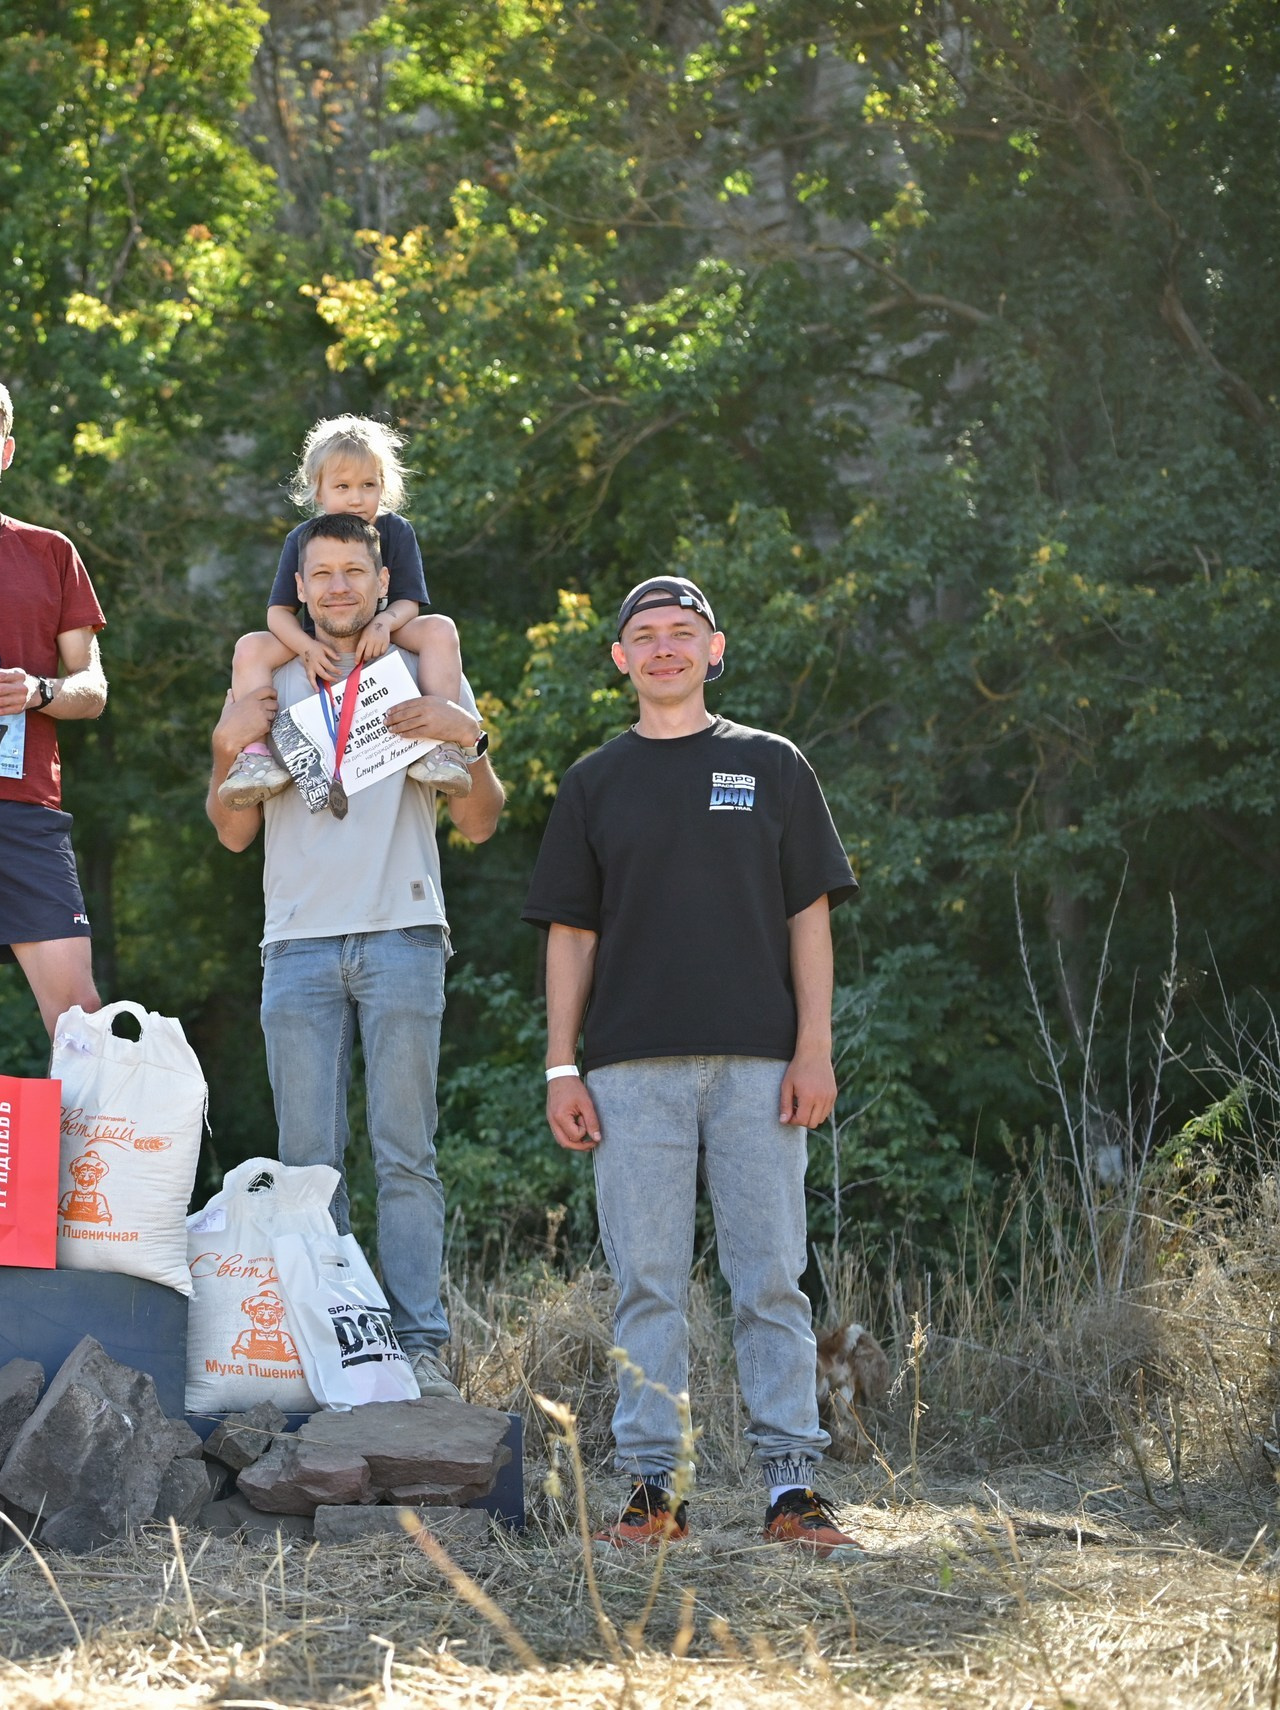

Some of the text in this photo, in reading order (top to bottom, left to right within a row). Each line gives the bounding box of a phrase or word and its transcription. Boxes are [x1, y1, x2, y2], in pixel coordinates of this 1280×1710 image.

[360, 687, 389, 708] МЕСТО
[360, 708, 379, 721] забеге
[355, 717, 382, 737] SPACE
[354, 726, 388, 749] ЗАЙЦЕВ
[351, 743, 382, 761] дистанции
[356, 755, 385, 778] Смирнов
[714, 775, 753, 784] ЯДРО
[710, 788, 755, 807] DON
[62, 1225, 139, 1241] Пшеничная
[189, 1252, 279, 1279] Светл
[205, 1360, 305, 1379] Мука Пшенич
